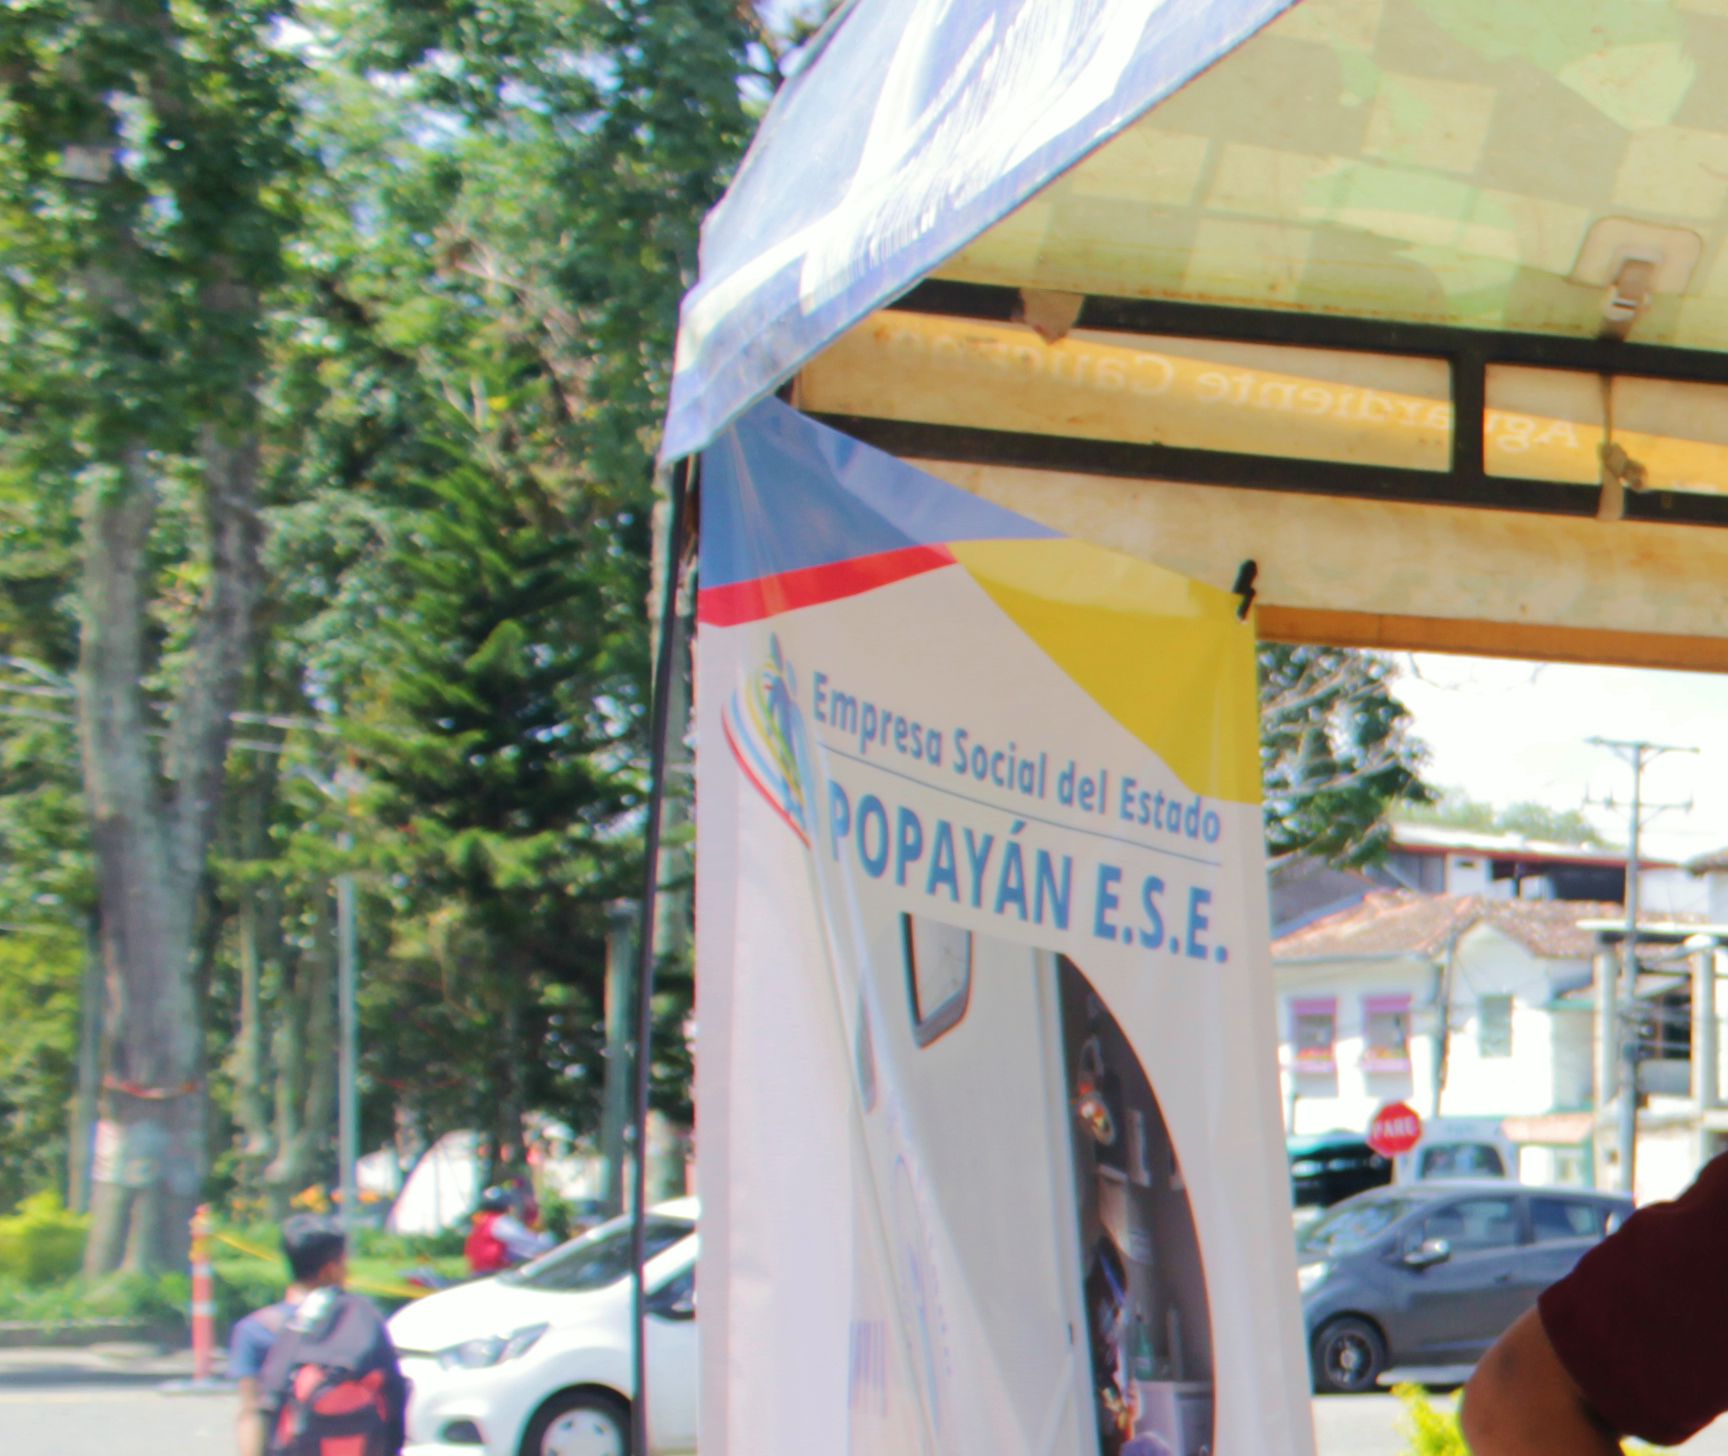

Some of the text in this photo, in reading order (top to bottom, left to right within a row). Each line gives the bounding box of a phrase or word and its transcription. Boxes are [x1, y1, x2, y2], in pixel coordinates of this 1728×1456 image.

[813, 670, 1221, 845] Empresa Social del Estado
[828, 779, 1229, 965] POPAYÁN E.S.E.
[1374, 1114, 1416, 1139] PARE
